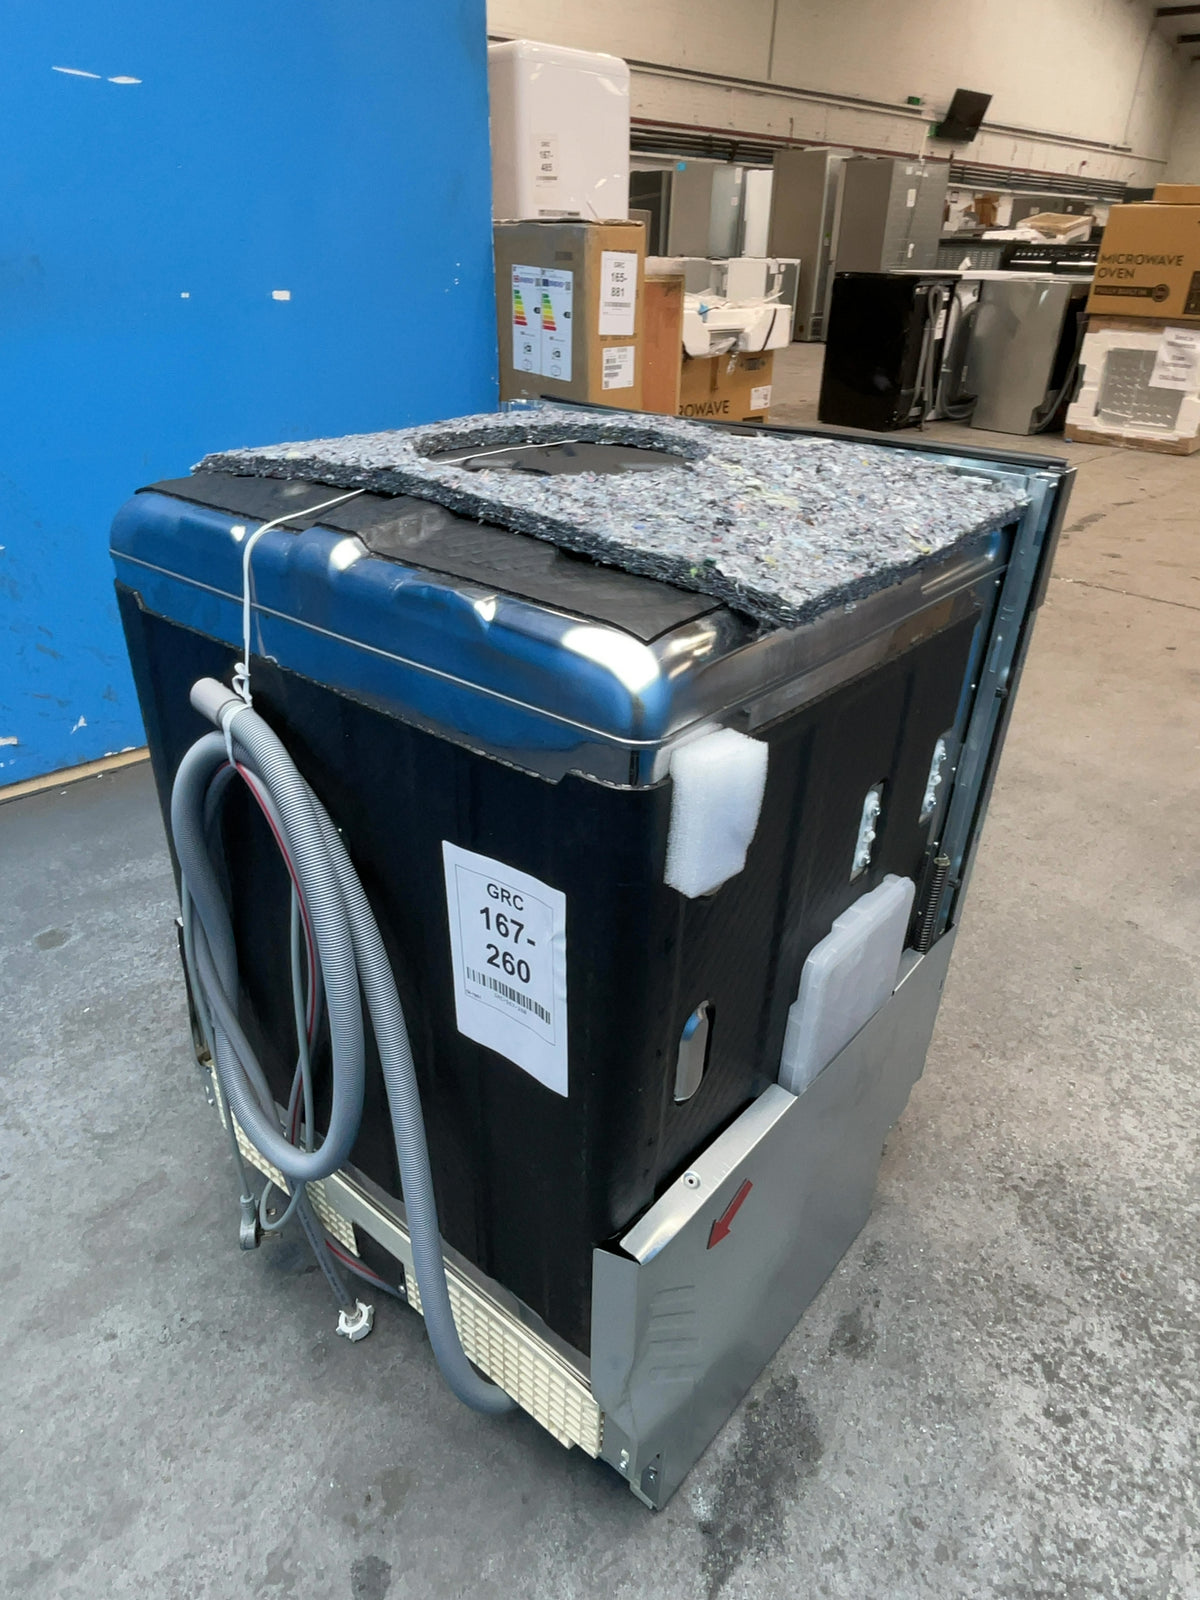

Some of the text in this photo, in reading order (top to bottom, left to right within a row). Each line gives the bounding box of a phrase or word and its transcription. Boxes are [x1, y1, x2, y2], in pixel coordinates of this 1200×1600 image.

[1100, 254, 1184, 266] MICROWAVE
[611, 272, 628, 283] 165-
[1097, 267, 1135, 278] OVEN
[486, 883, 524, 911] GRC
[480, 907, 536, 947] 167-
[486, 943, 531, 984] 260
